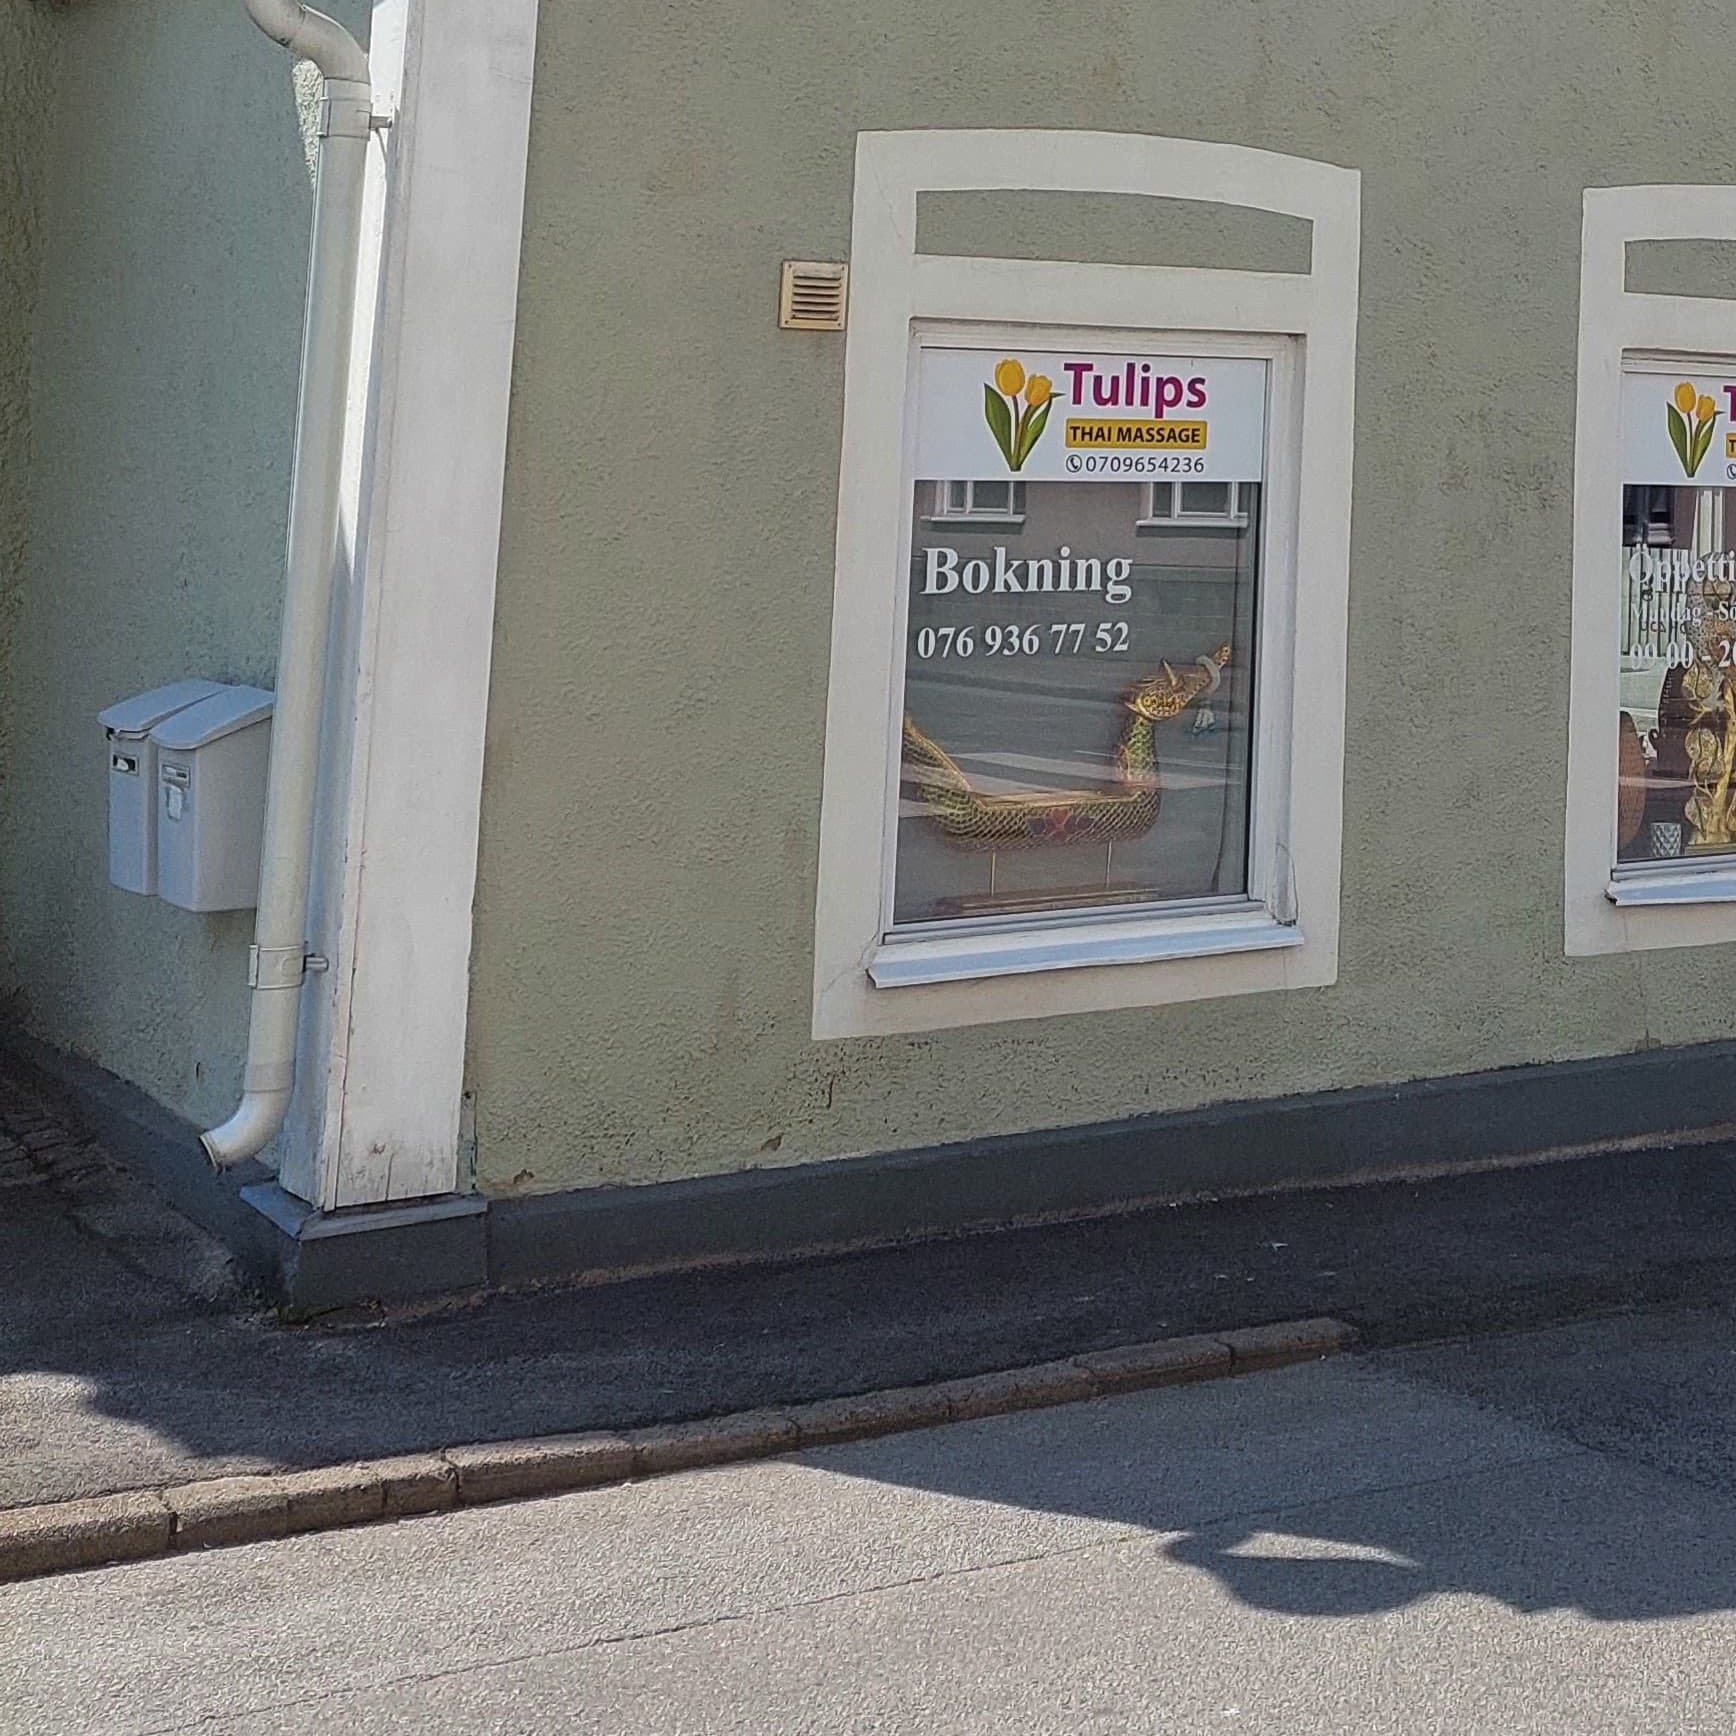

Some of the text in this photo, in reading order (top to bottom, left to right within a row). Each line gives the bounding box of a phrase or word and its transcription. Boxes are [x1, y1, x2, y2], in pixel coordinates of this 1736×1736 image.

[1064, 362, 1206, 419] Tulips
[1070, 426, 1201, 443] THAI MASSAGE
[1086, 456, 1205, 473] 0709654236
[920, 546, 1133, 604] Bokning
[917, 622, 1129, 659] 076 936 77 52
[1630, 640, 1694, 670] 0900
